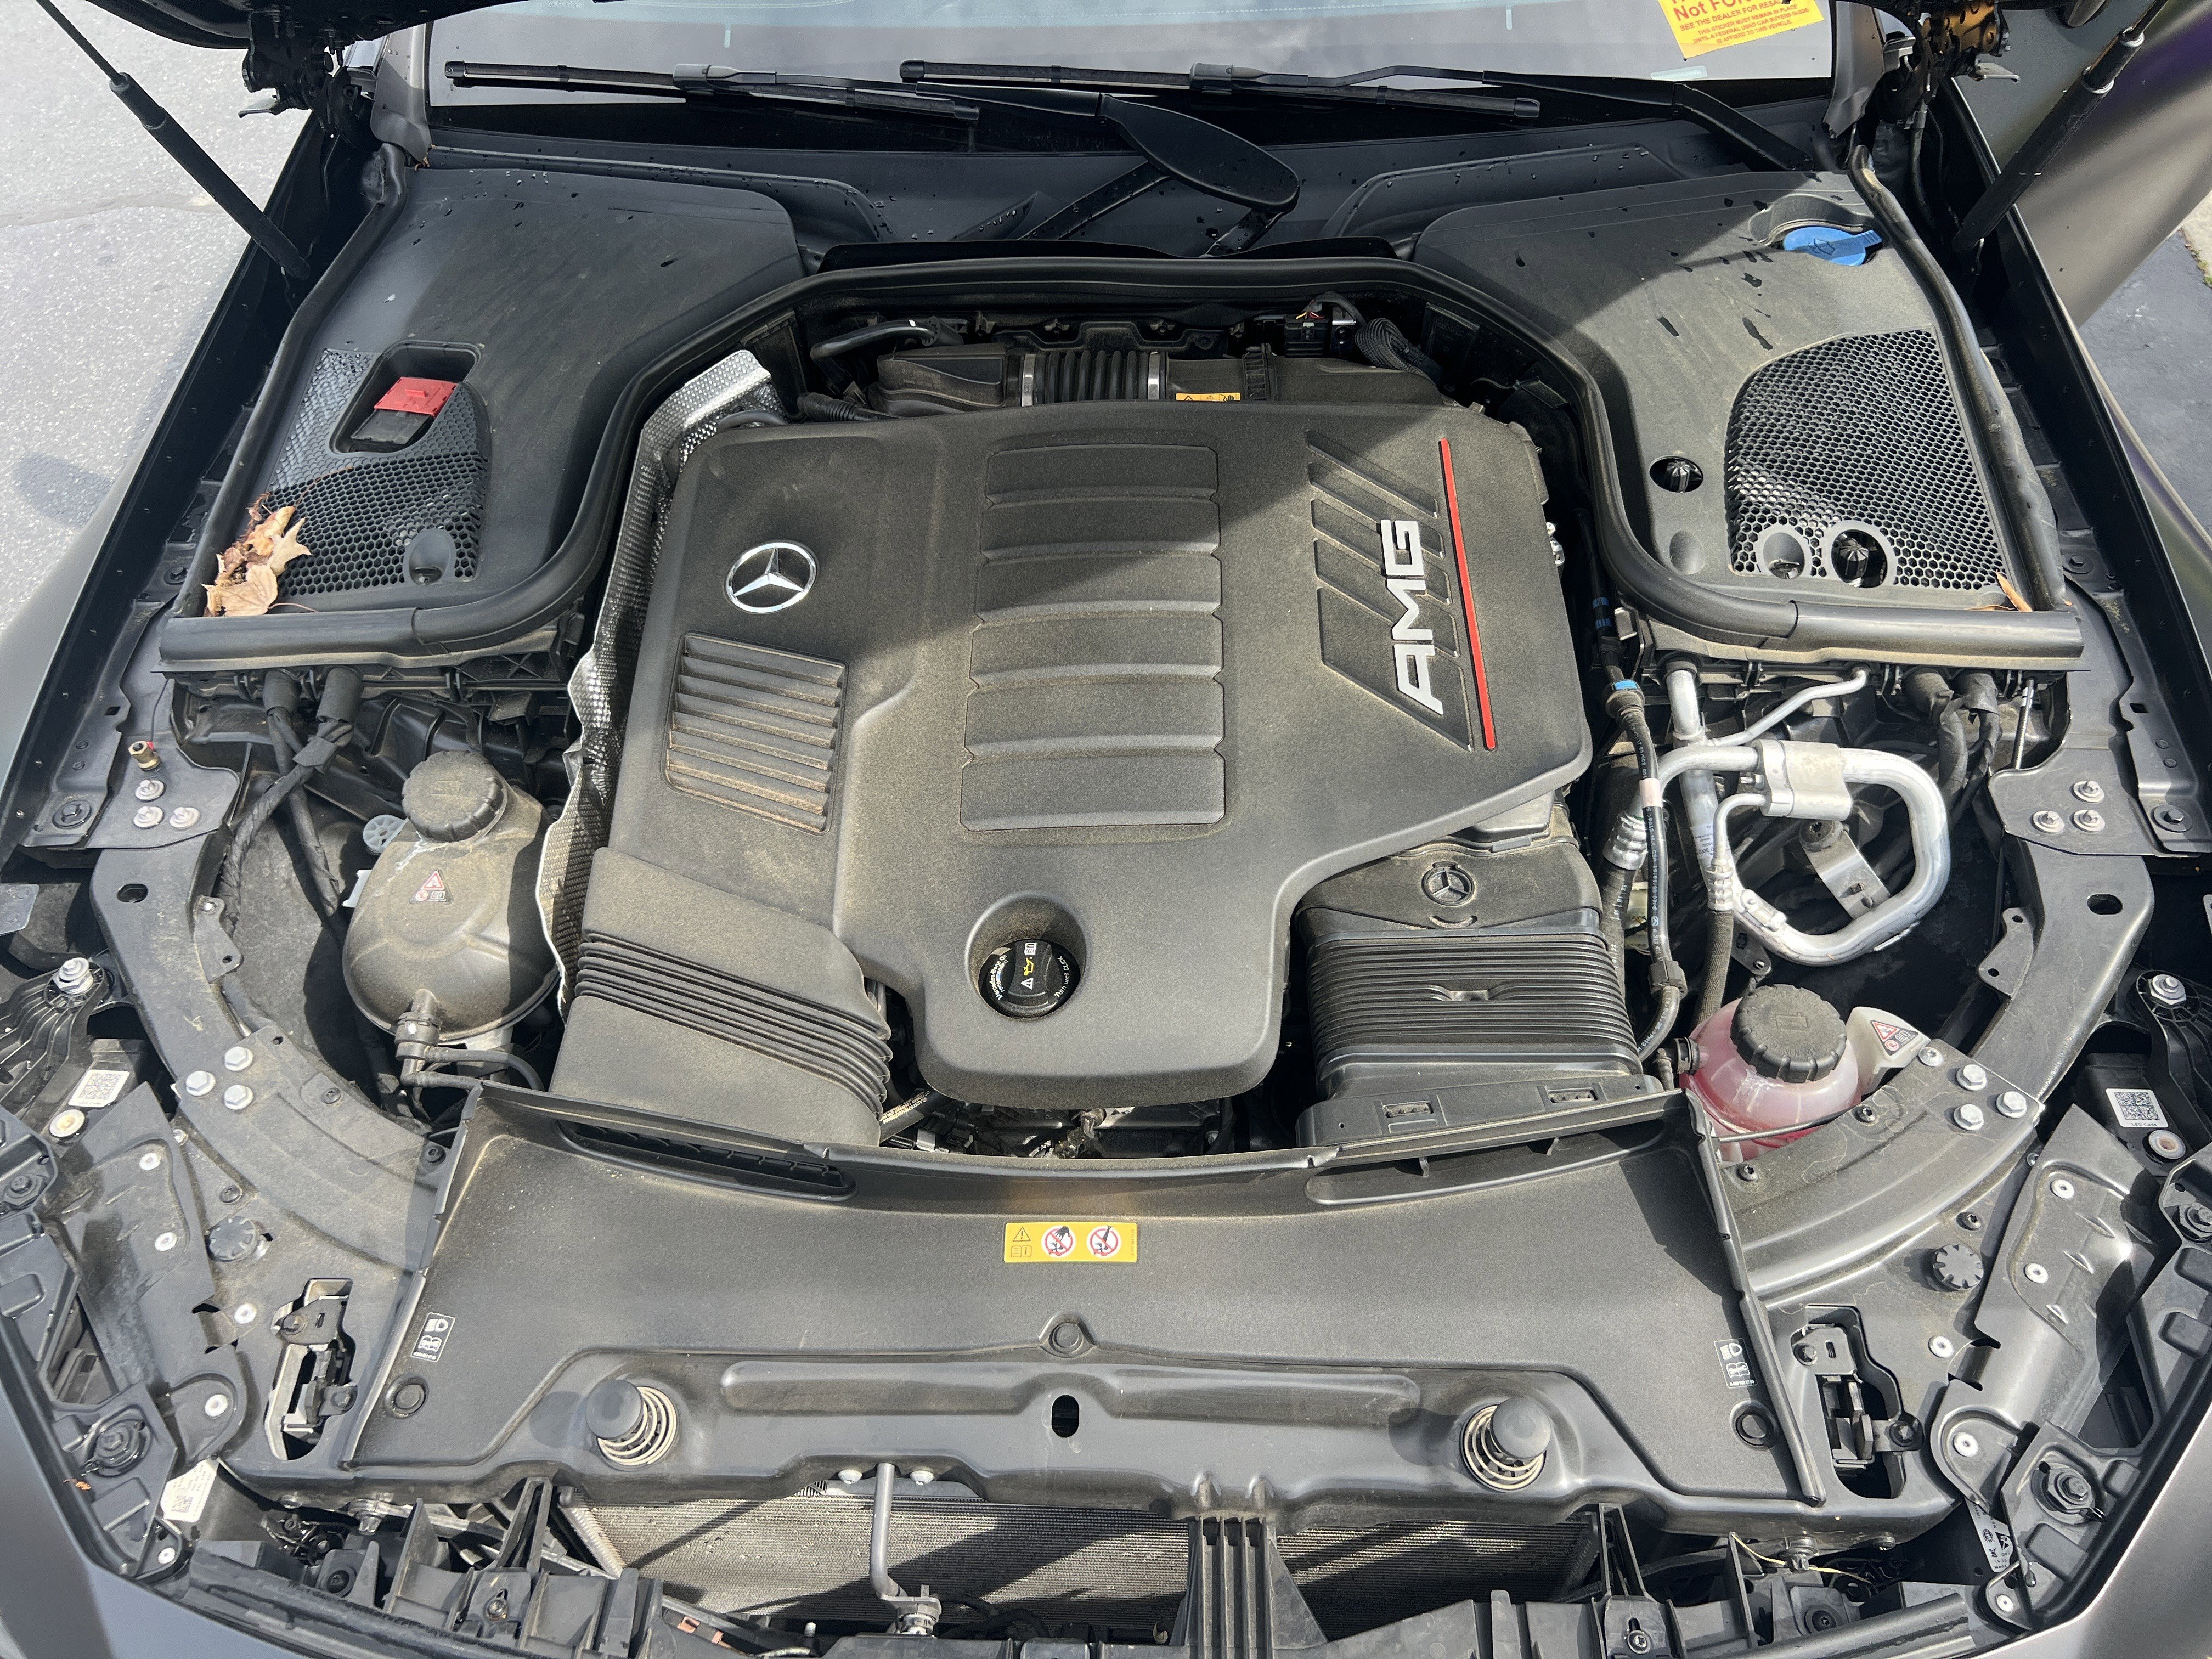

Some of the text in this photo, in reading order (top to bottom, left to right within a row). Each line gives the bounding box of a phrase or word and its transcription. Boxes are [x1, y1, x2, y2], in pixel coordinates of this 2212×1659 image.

[1673, 2, 1708, 21] Not
[1680, 22, 1695, 31] SEE
[1696, 18, 1712, 26] THE
[1712, 9, 1741, 21] DEALER
[1742, 5, 1758, 13] FOR
[1712, 21, 1734, 31] STICKER
[1735, 16, 1750, 25] MUST
[1751, 11, 1773, 20] REMAIN
[1716, 27, 1741, 37] FEDERAL
[1769, 13, 1791, 22] BUYERS
[1792, 8, 1809, 16] GUIDE
[1723, 32, 1746, 42] AFFIXED
[1381, 519, 1444, 715] AMG
[1057, 956, 1069, 972] CLICK
[989, 961, 1003, 1000] Mercedes-Benz
[1054, 986, 1066, 998] Turn
